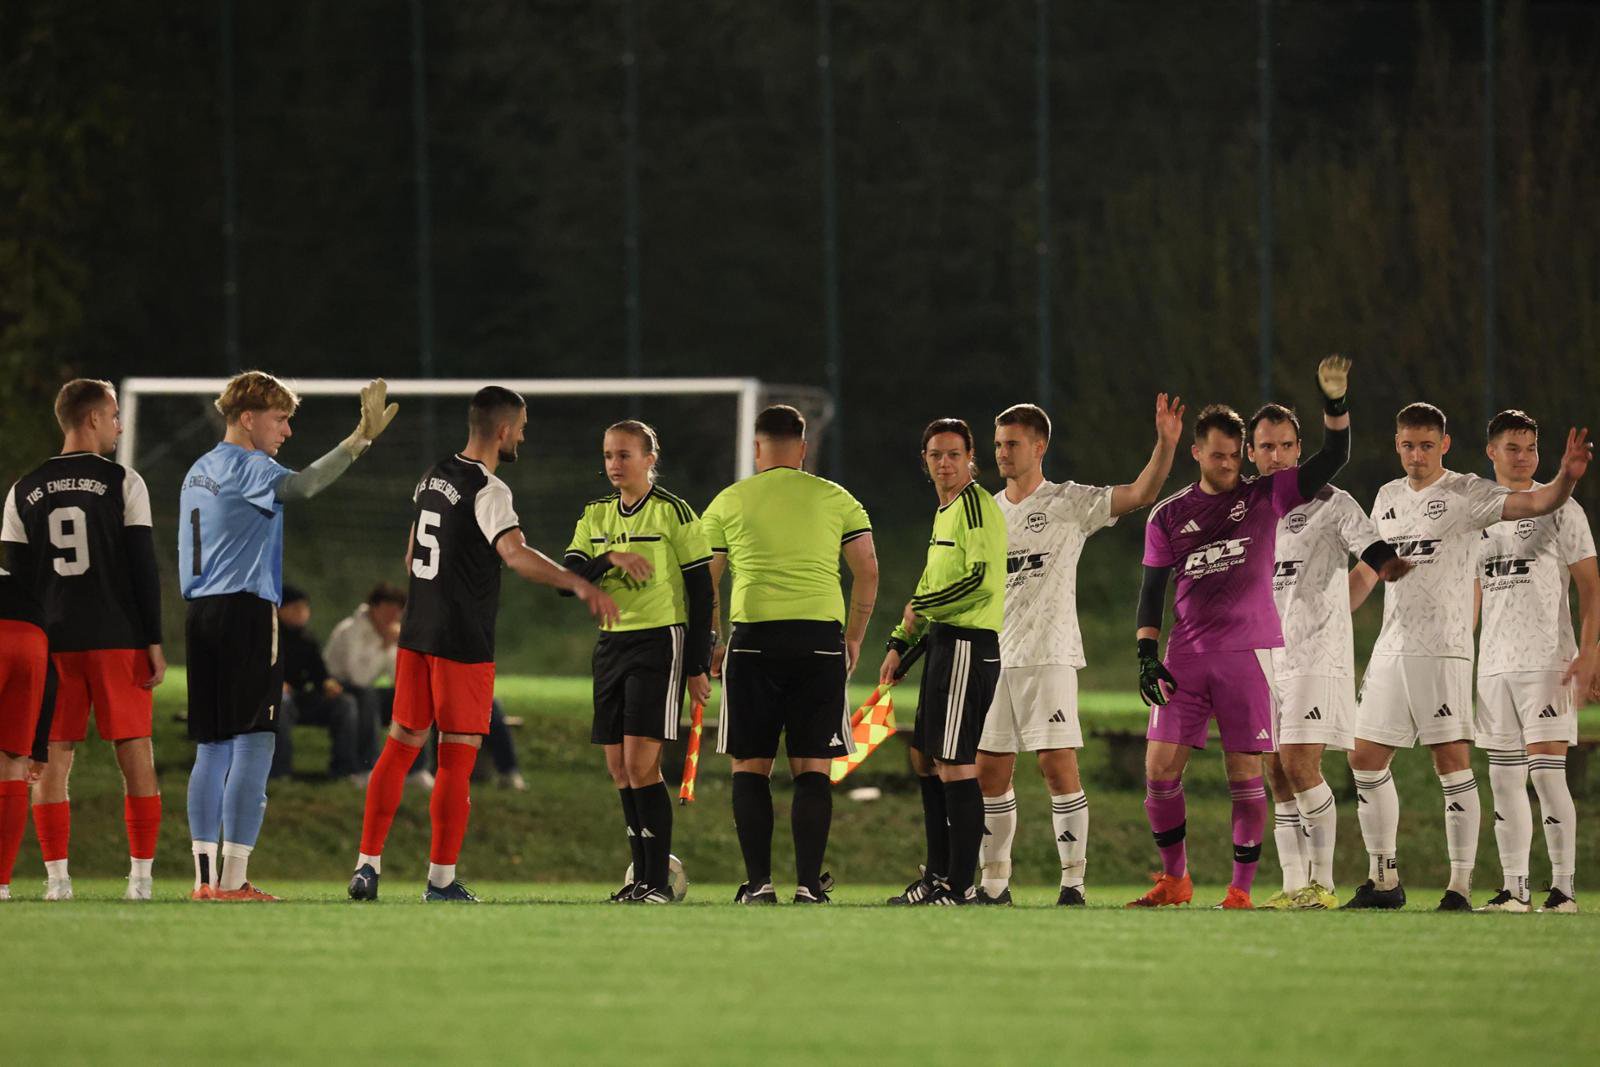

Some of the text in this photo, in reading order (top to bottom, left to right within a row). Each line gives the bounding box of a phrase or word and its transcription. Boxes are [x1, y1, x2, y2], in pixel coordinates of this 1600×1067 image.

[26, 478, 108, 505] TUS ENGELSBERG
[48, 506, 90, 577] 9
[190, 507, 202, 576] 1
[412, 510, 441, 580] 5
[268, 704, 275, 721] 1
